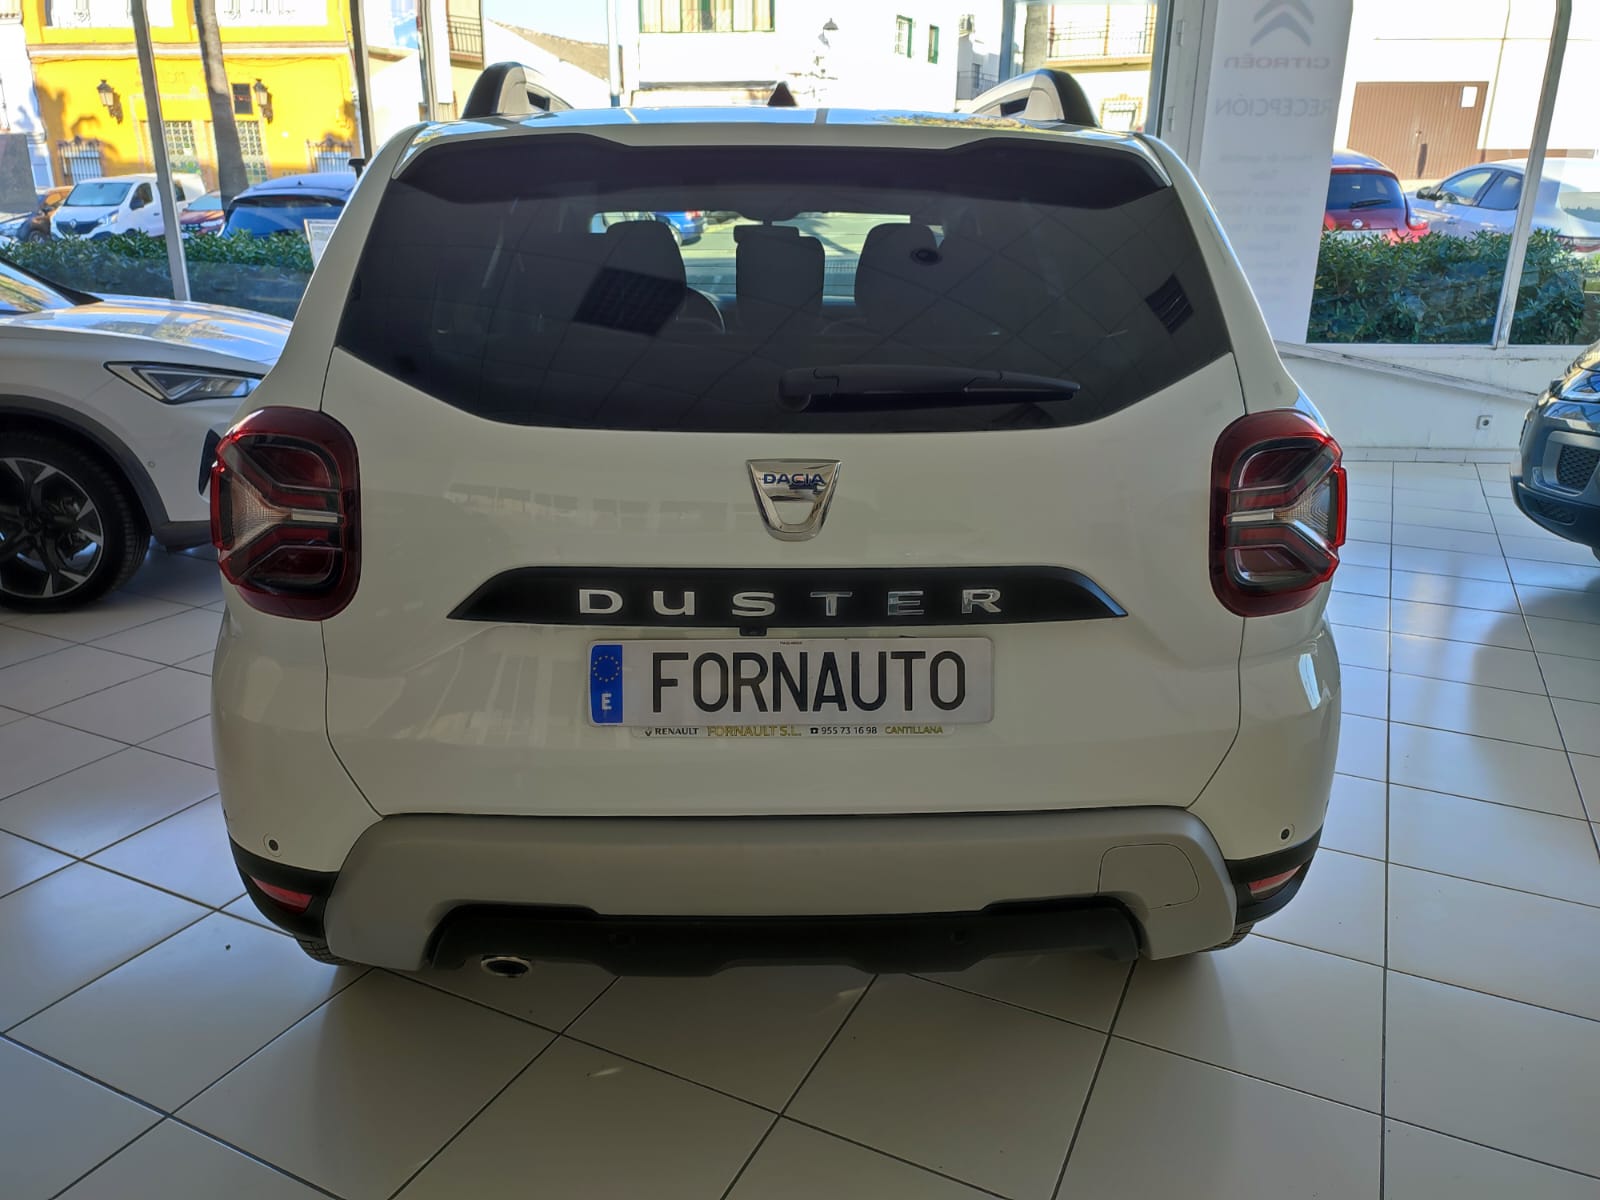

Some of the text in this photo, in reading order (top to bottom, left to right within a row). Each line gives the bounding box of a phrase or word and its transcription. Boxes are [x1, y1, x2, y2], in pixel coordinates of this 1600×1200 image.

[763, 473, 825, 485] DACIA
[577, 588, 1004, 618] DUSTER
[651, 650, 966, 713] FORNAUTO
[600, 693, 613, 711] E
[654, 725, 944, 737] RENAULT FORNAULT S.L. 955 73 16 98 CANTILLANA
